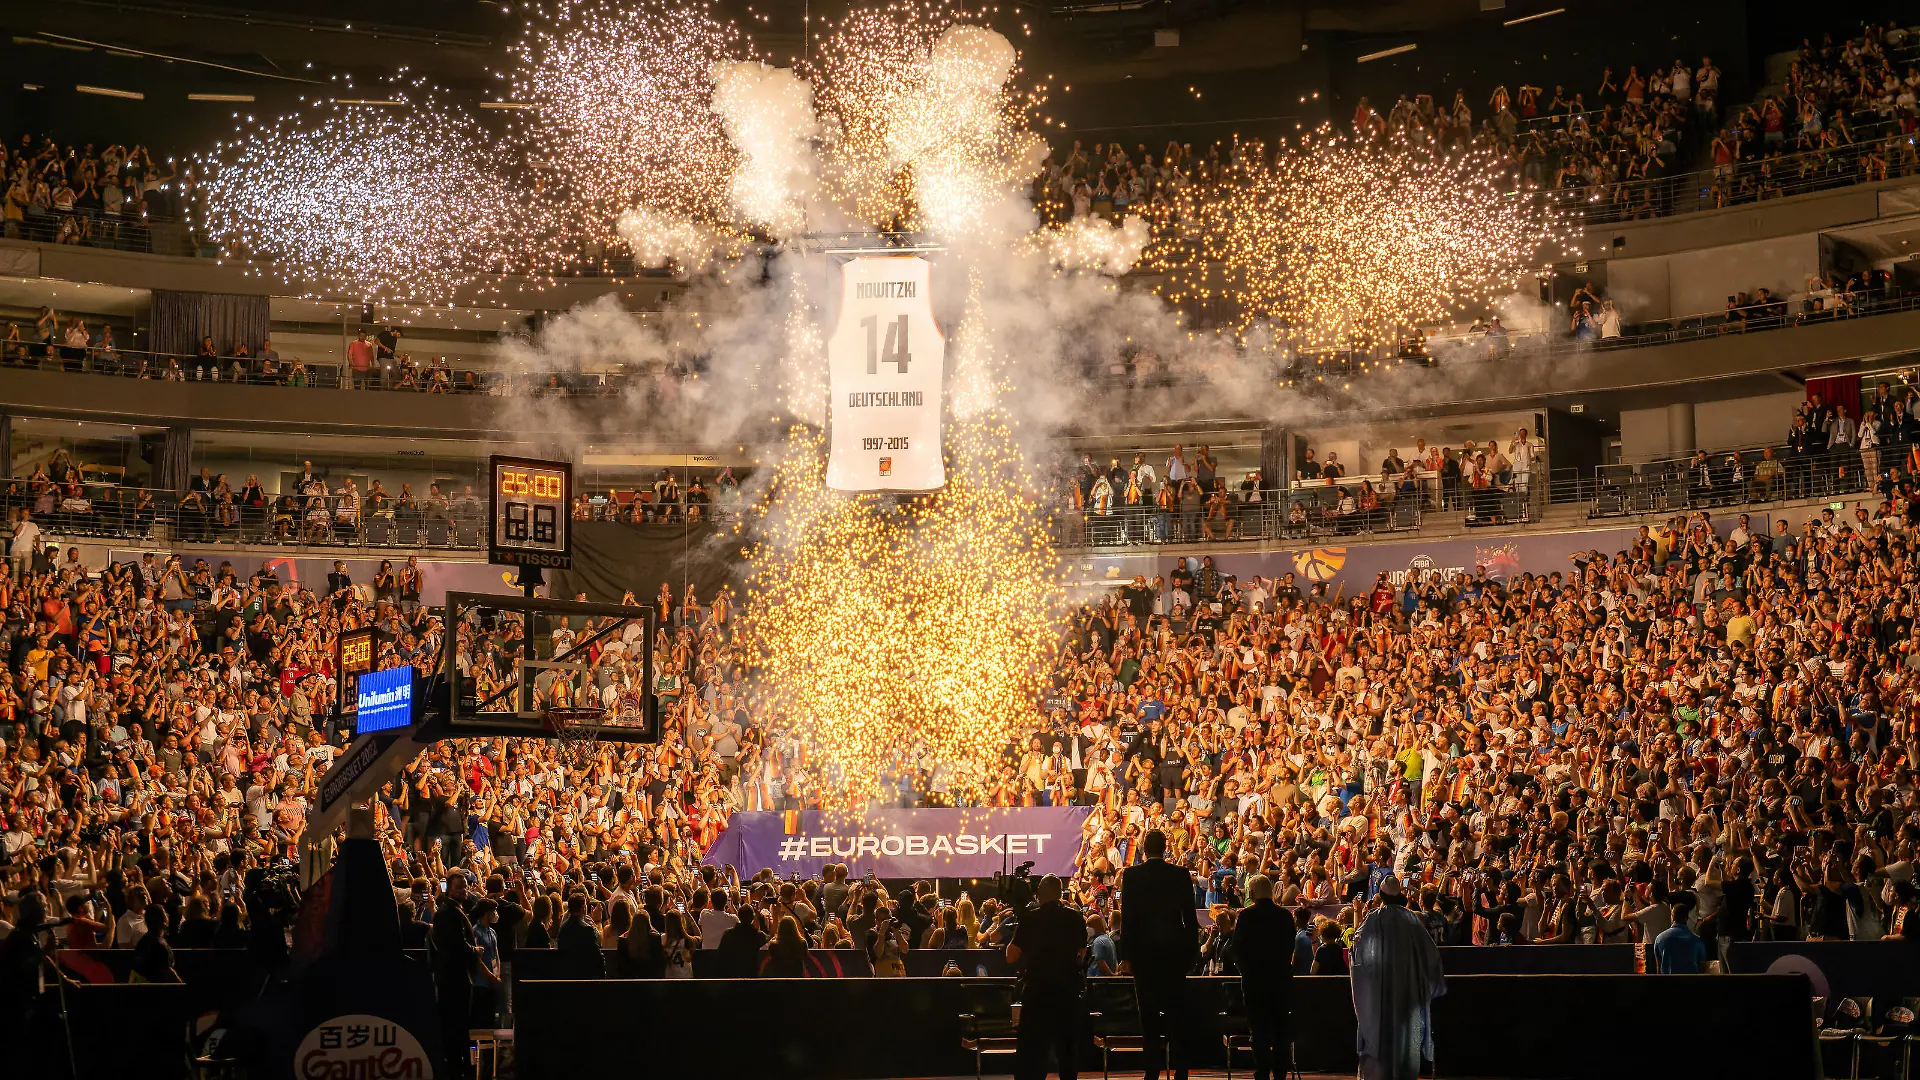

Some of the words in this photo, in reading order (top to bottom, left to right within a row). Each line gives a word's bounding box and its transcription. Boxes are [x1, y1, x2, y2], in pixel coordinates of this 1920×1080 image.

[856, 281, 916, 299] NOWITZKI
[860, 314, 912, 374] 14
[849, 391, 923, 408] DEUTSCHLAND
[862, 436, 909, 450] 1997-2015
[502, 471, 561, 498] 25:00
[515, 551, 571, 568] TISSOT
[1414, 560, 1430, 568] FIBA
[343, 641, 371, 665] 25:00
[358, 687, 394, 709] Unilumin
[778, 833, 1052, 861] #EUROBASKET
[319, 1024, 397, 1049] 百岁山
